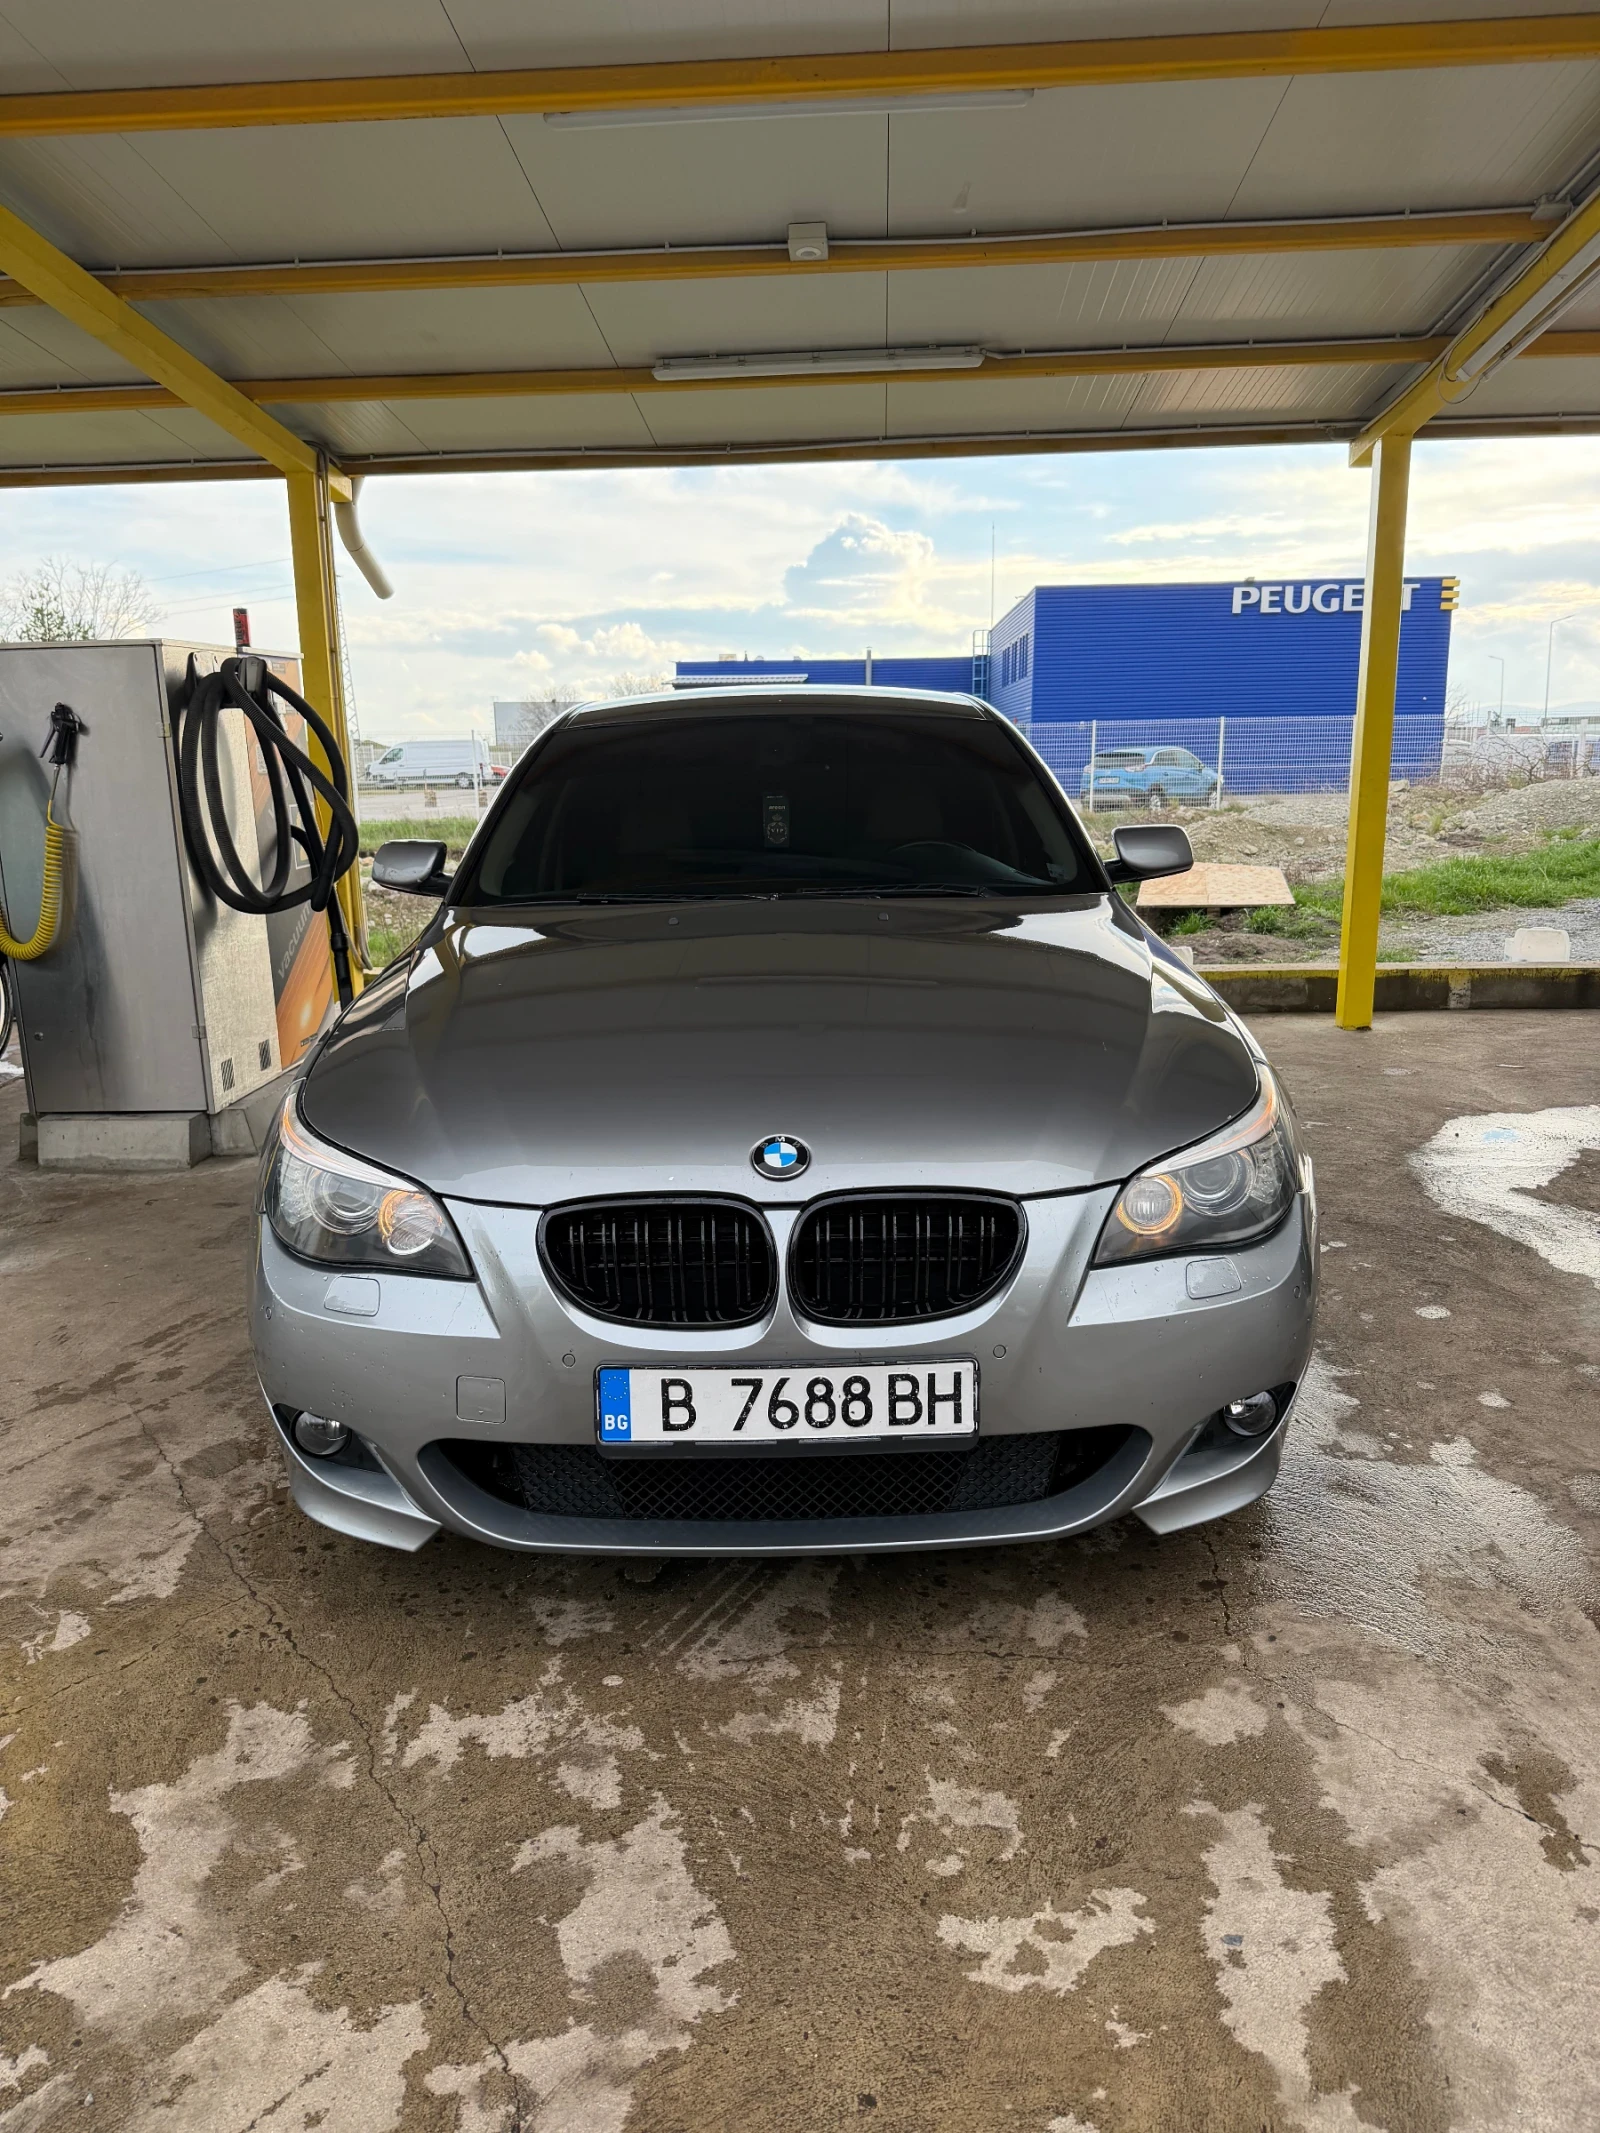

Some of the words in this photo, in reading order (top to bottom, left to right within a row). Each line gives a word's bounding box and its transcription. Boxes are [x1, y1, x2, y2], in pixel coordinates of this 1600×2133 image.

[1231, 584, 1421, 614] PEUGET
[660, 1377, 697, 1432] B
[731, 1374, 873, 1431] 7688
[887, 1370, 963, 1427] BH
[604, 1413, 629, 1431] BG
